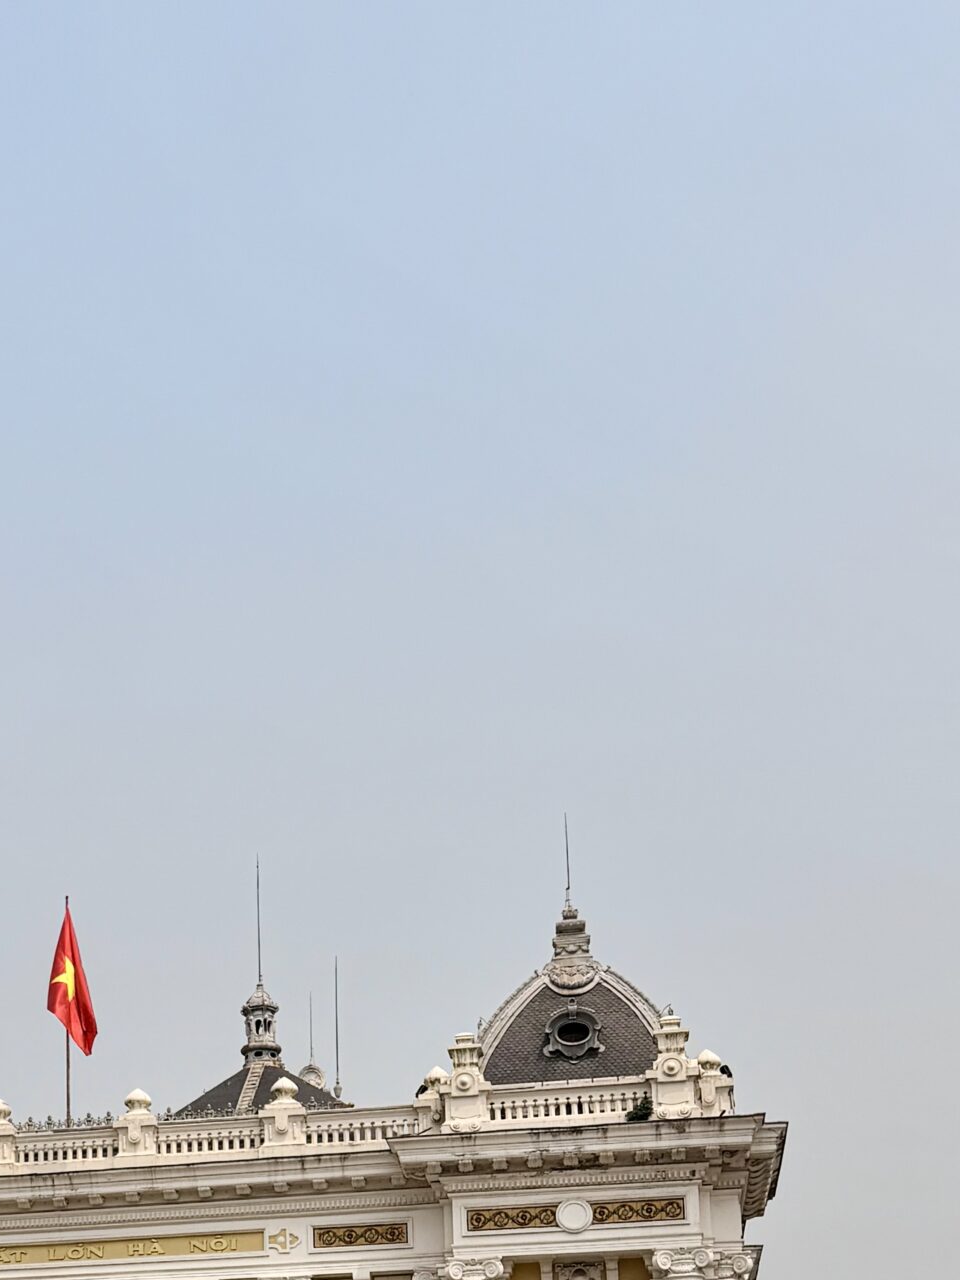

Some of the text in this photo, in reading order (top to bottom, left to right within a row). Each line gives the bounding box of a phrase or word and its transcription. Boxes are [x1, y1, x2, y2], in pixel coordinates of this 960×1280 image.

[48, 1243, 105, 1261] LỚN
[127, 1239, 166, 1256] HÀ
[189, 1235, 239, 1254] NỘI
